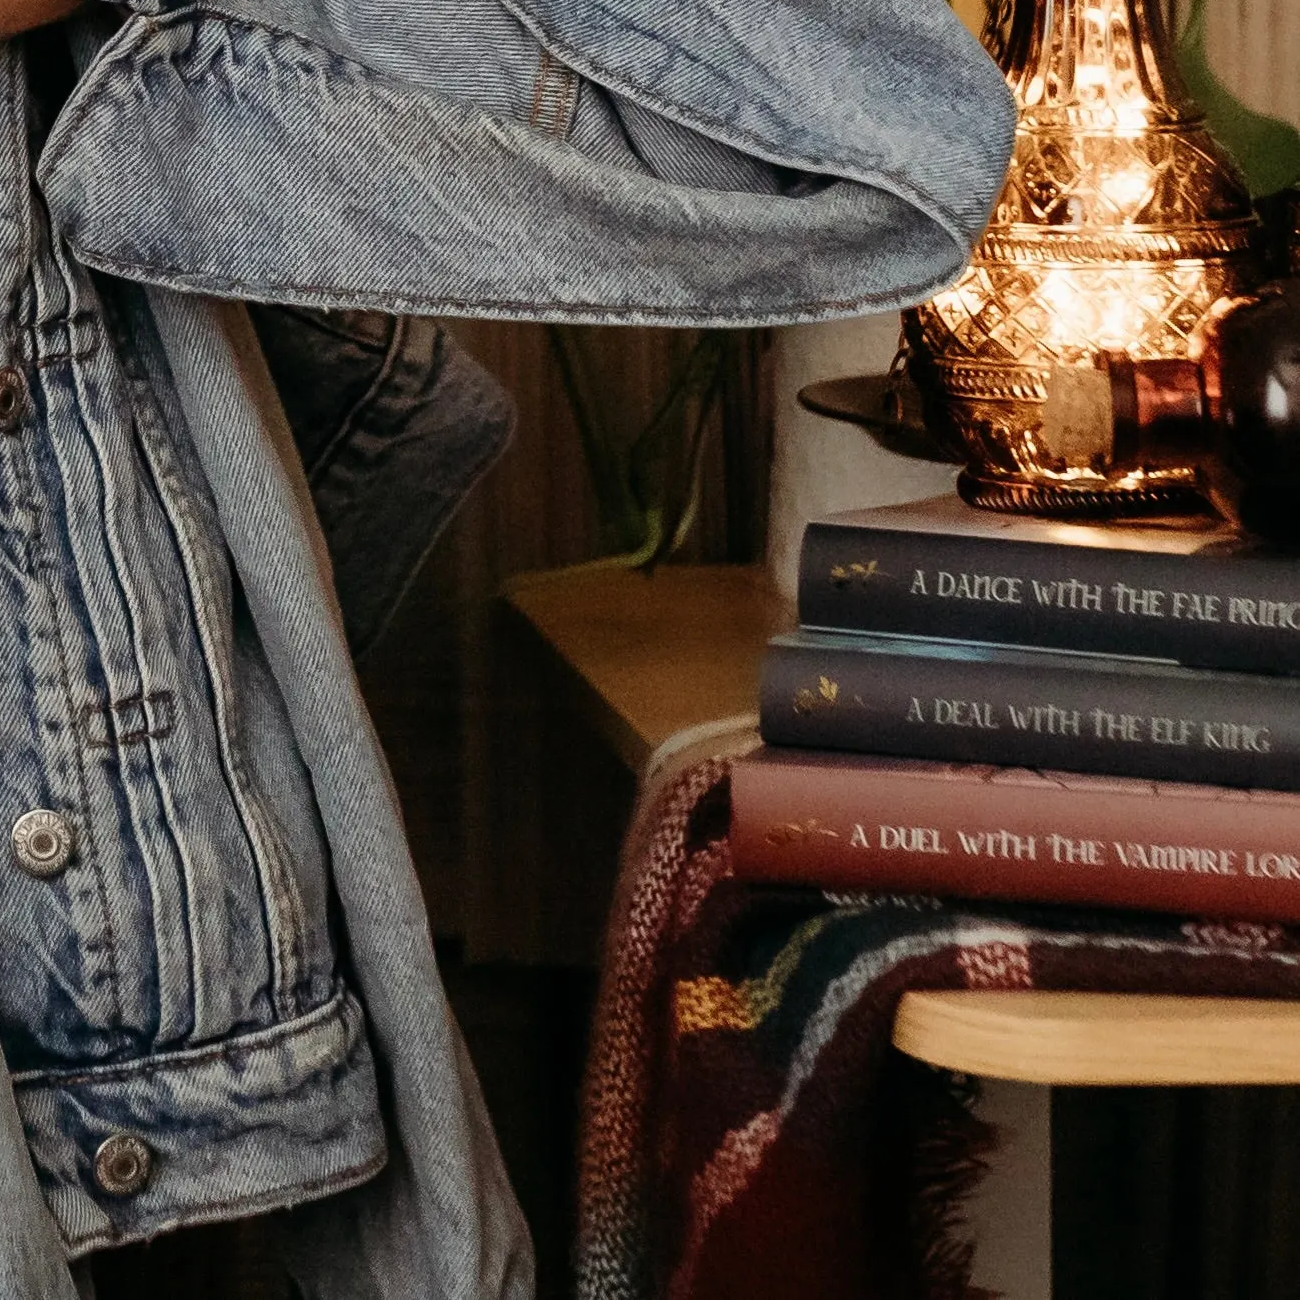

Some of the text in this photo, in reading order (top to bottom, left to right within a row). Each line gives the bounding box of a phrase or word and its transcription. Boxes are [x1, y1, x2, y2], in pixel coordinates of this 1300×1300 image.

[909, 569, 929, 596] A
[937, 570, 1024, 605] DANCE
[1031, 577, 1104, 613] WITH
[1110, 581, 1166, 617] THE
[1171, 592, 1221, 623] FAE
[906, 696, 1272, 754] A DEAL WITH THE ELF KING
[849, 823, 871, 850] A
[879, 824, 949, 855] DUEL
[956, 829, 1037, 862] WITH
[1046, 831, 1106, 867] THE
[1112, 841, 1239, 877] VAMPIRE
